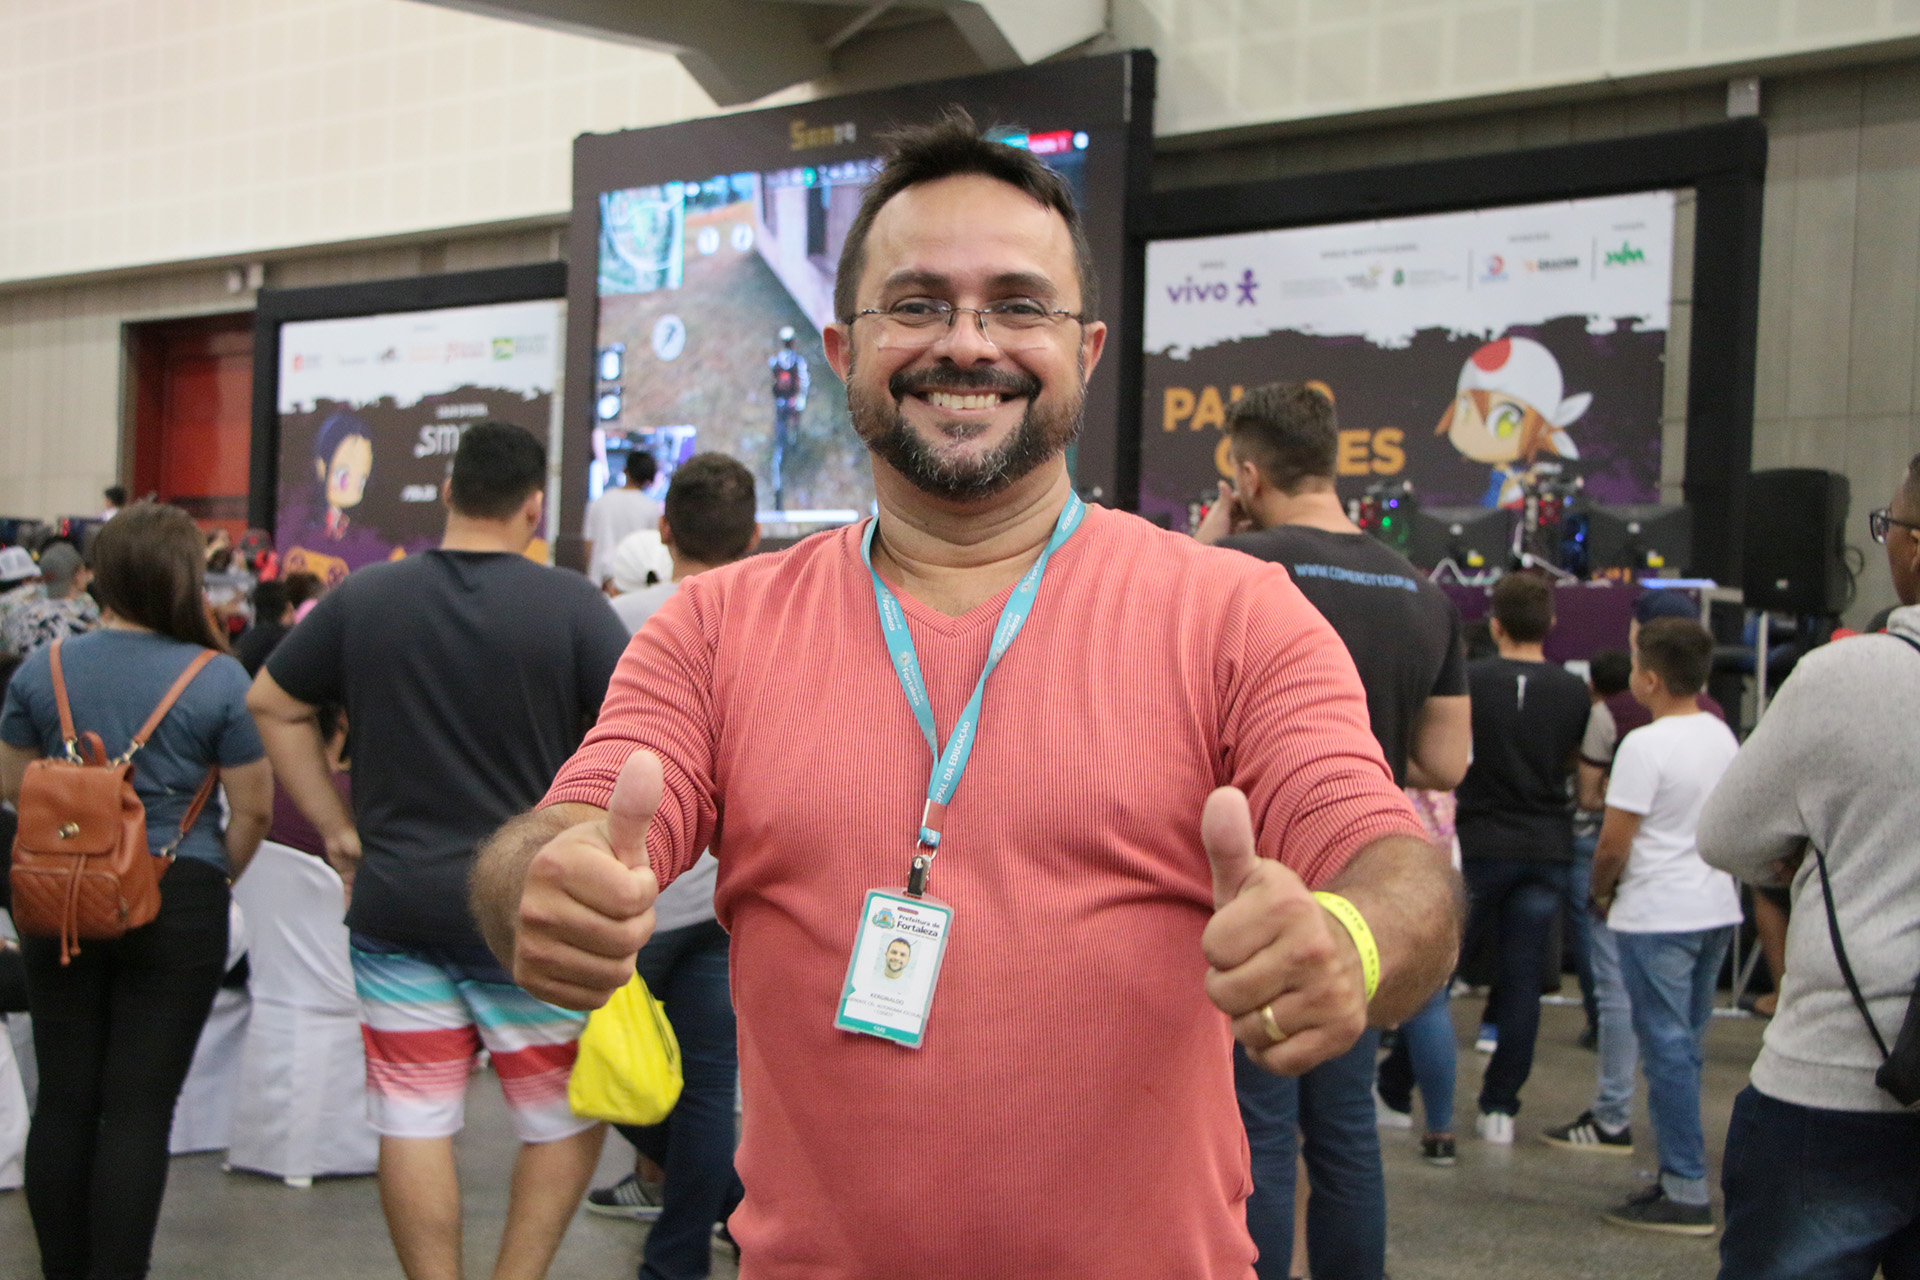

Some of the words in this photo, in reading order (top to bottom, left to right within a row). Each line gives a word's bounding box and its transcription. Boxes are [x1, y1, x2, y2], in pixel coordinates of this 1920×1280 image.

[1167, 275, 1228, 303] vivo
[902, 667, 919, 706] Fortaleza
[948, 720, 971, 766] EDUCAÇÃO
[944, 767, 955, 781] DA
[896, 921, 938, 937] Fortaleza
[898, 914, 930, 927] Prefeitura
[931, 921, 940, 929] de
